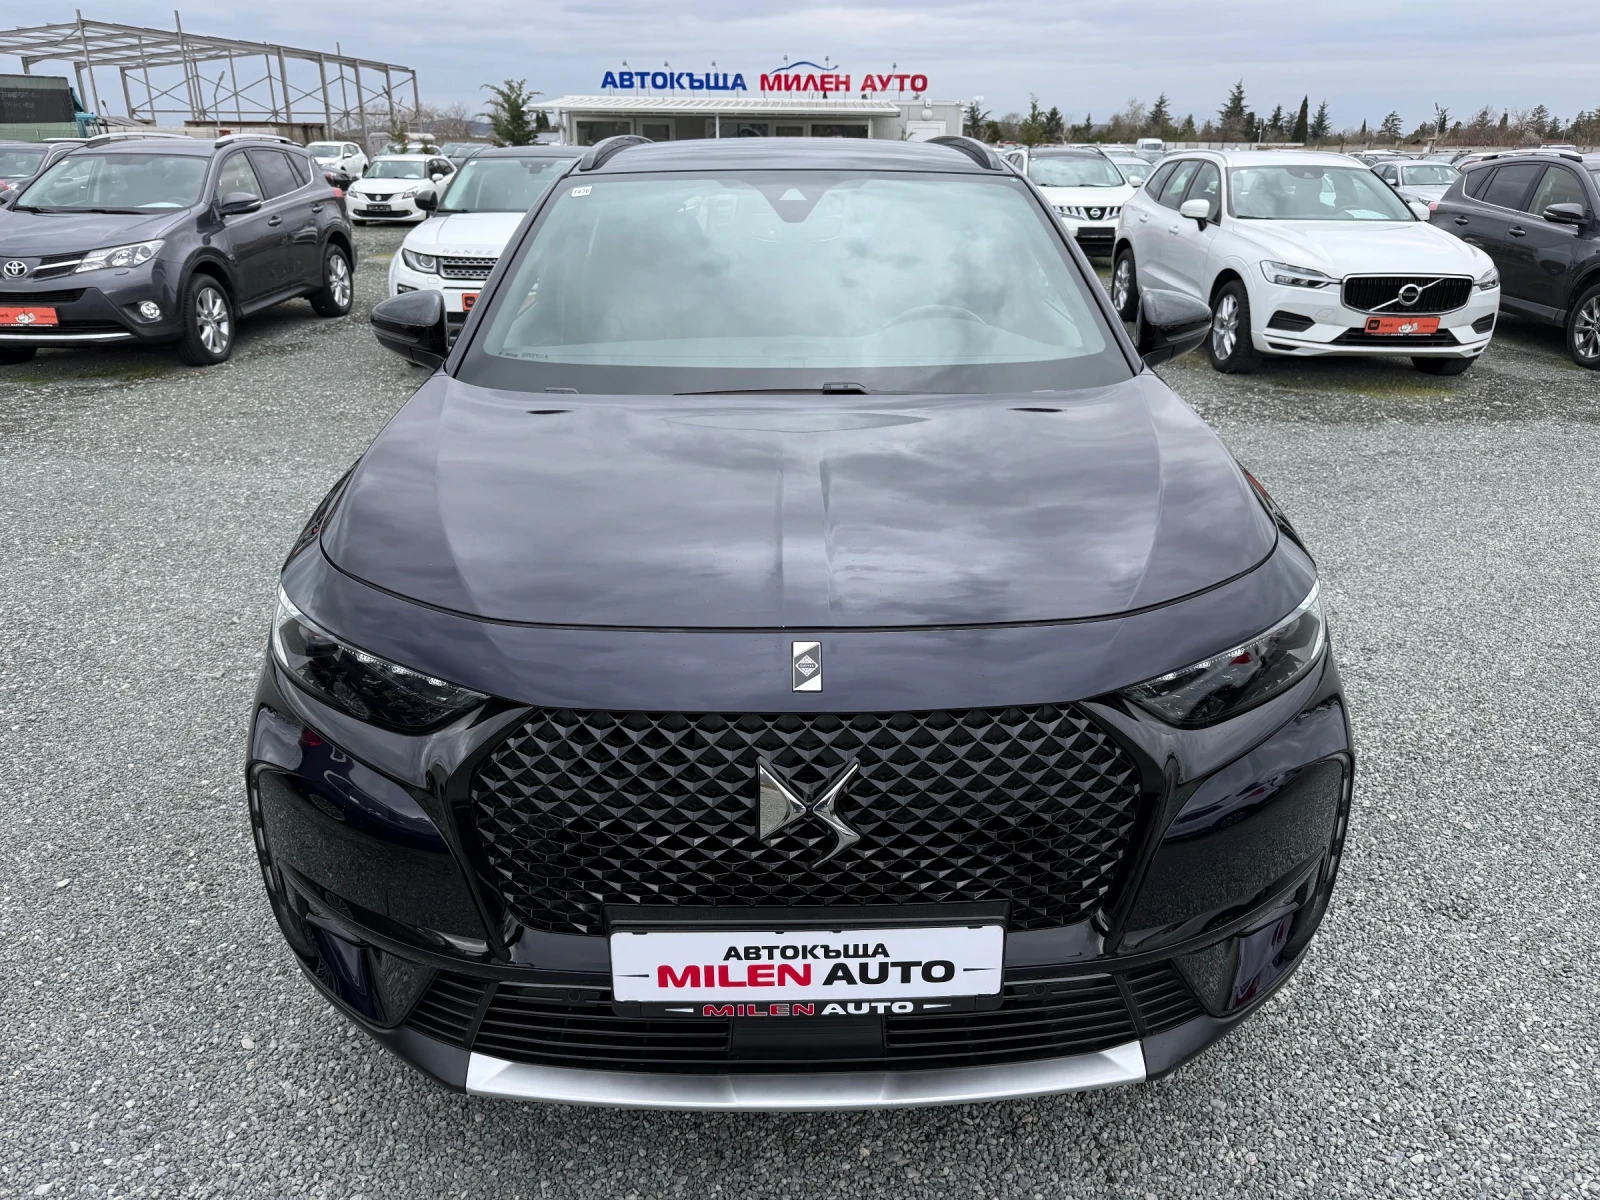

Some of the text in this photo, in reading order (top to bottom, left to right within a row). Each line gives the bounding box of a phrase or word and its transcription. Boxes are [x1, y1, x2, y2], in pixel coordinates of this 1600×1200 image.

[600, 71, 928, 92] АВТОКЪЩА МИЛЕН АУТО
[657, 960, 955, 988] MILEN AUTO
[702, 1001, 914, 1016] MILEN AUTO
